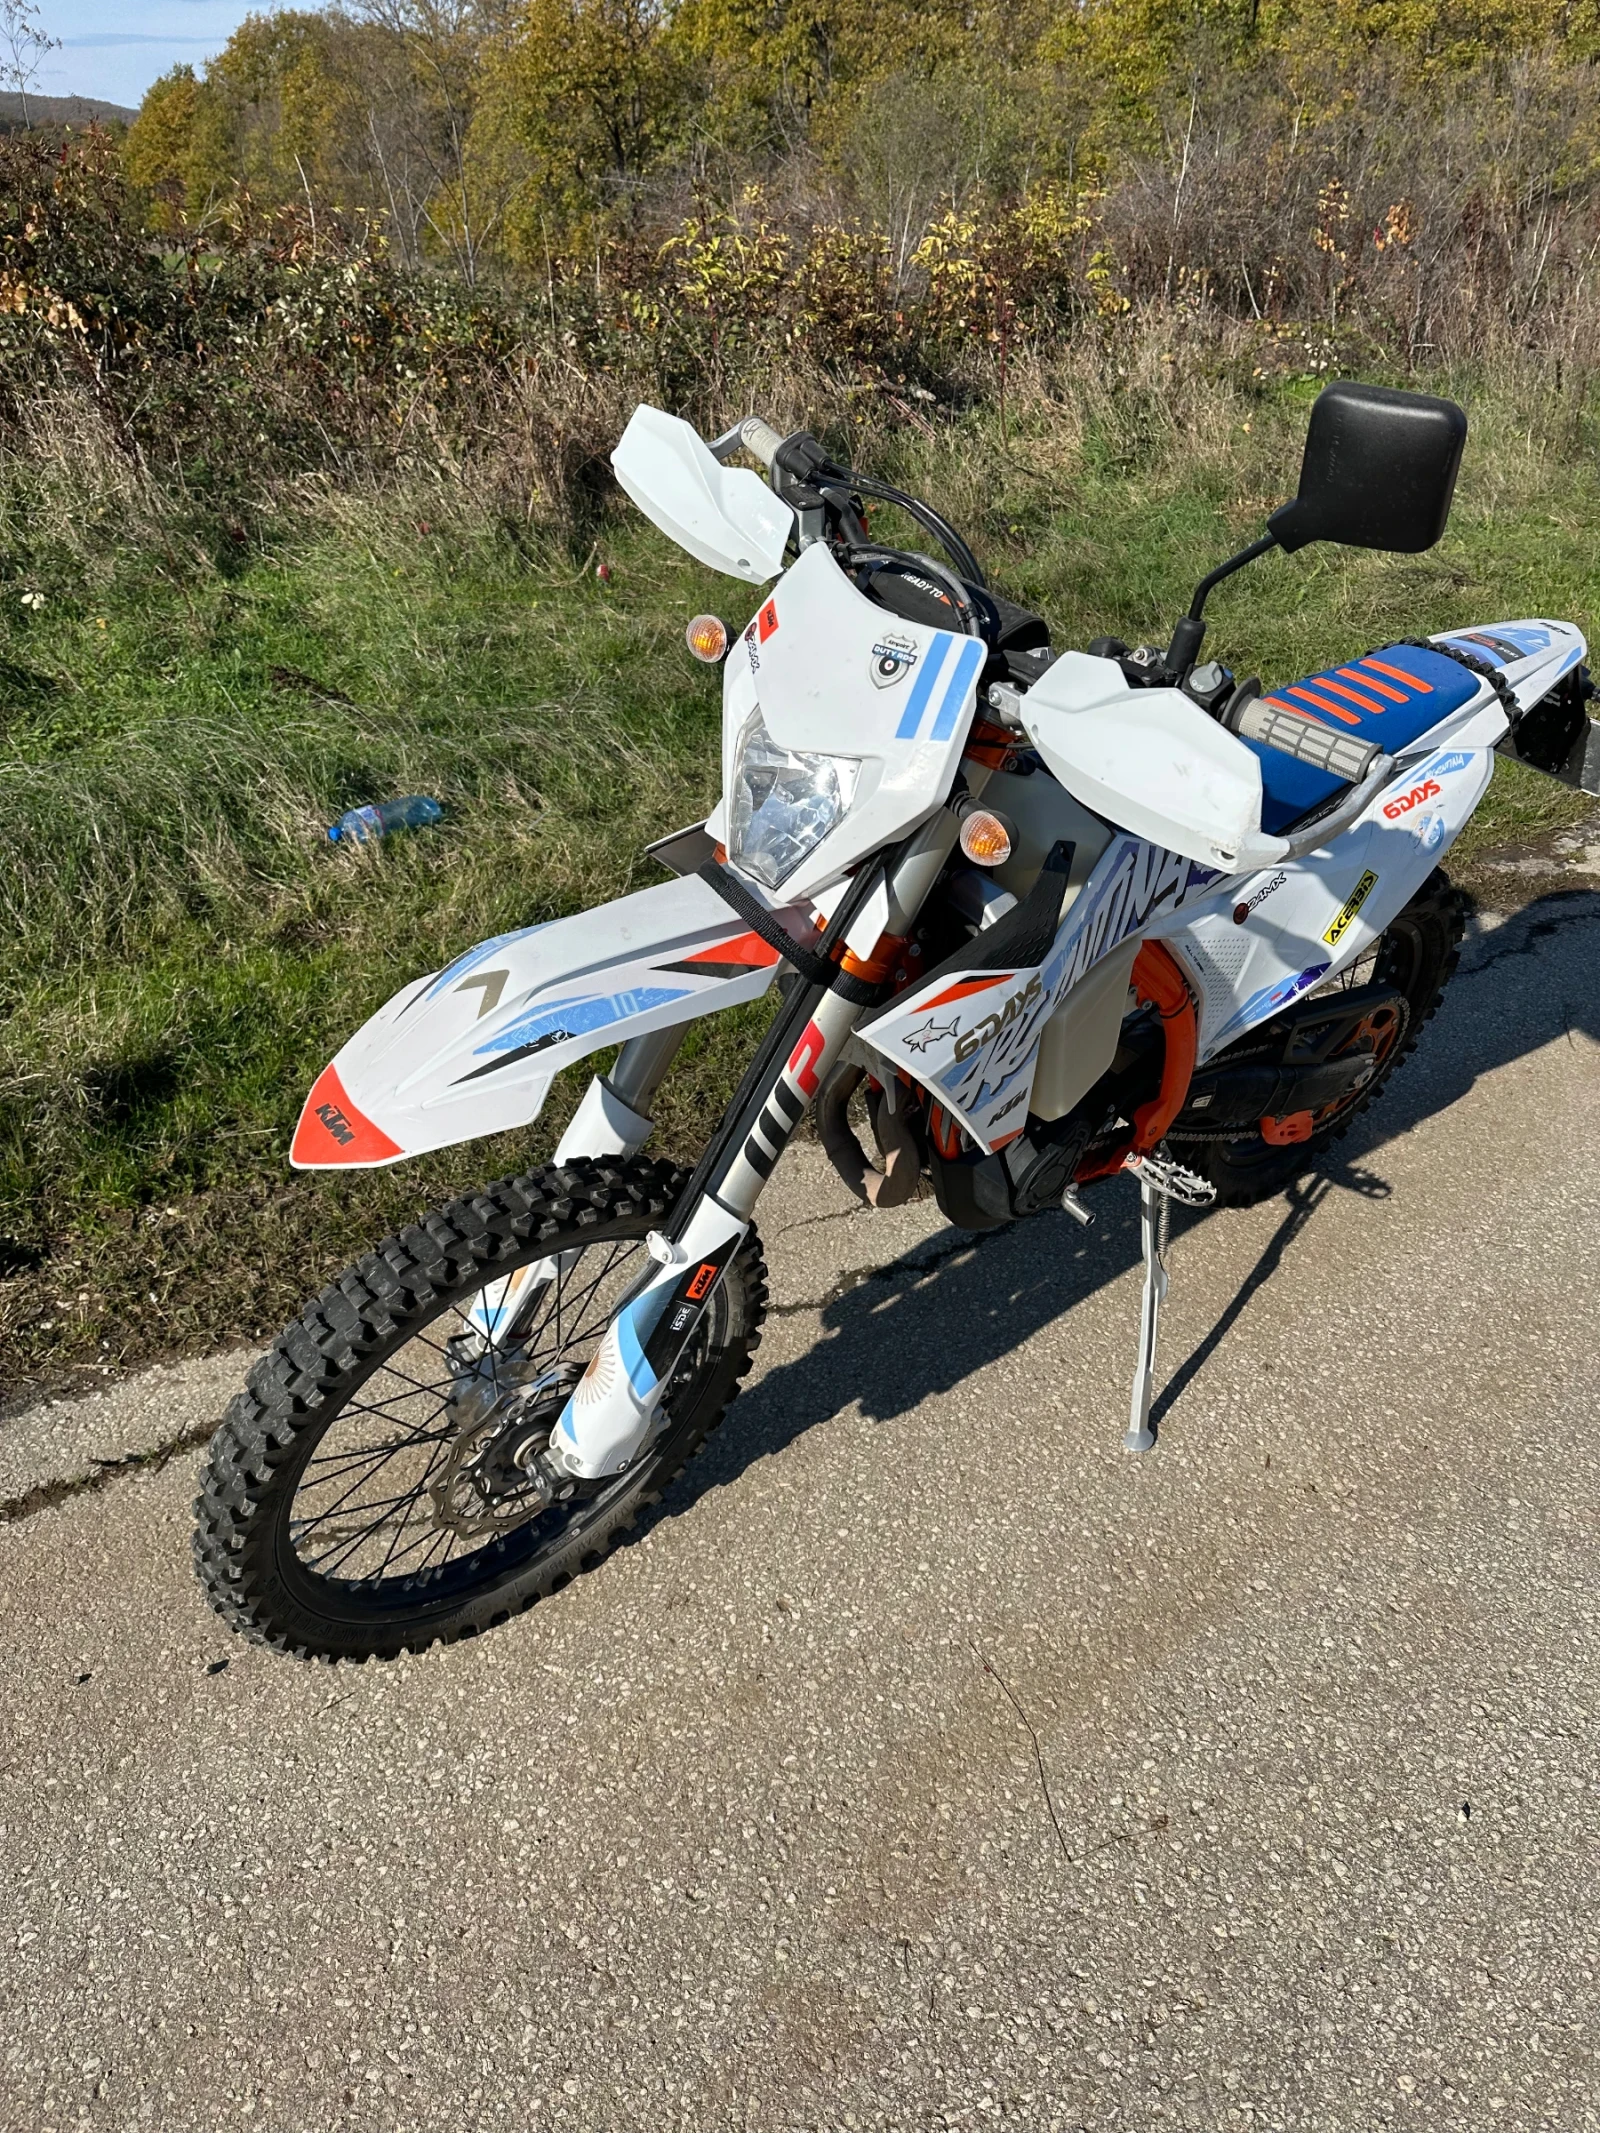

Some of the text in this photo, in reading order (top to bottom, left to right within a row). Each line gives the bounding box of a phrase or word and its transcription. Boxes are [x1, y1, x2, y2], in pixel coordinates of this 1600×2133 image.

[929, 587, 944, 598] TO
[873, 645, 915, 663] DUTY RDS
[1382, 778, 1441, 820] 6DAYS
[1246, 871, 1287, 914] 24MX
[953, 973, 1042, 1064] 6DAYS
[314, 1102, 356, 1146] KTM
[986, 1086, 1029, 1129] KTM
[694, 1268, 713, 1296] KTM
[672, 1307, 690, 1332] ISDE
